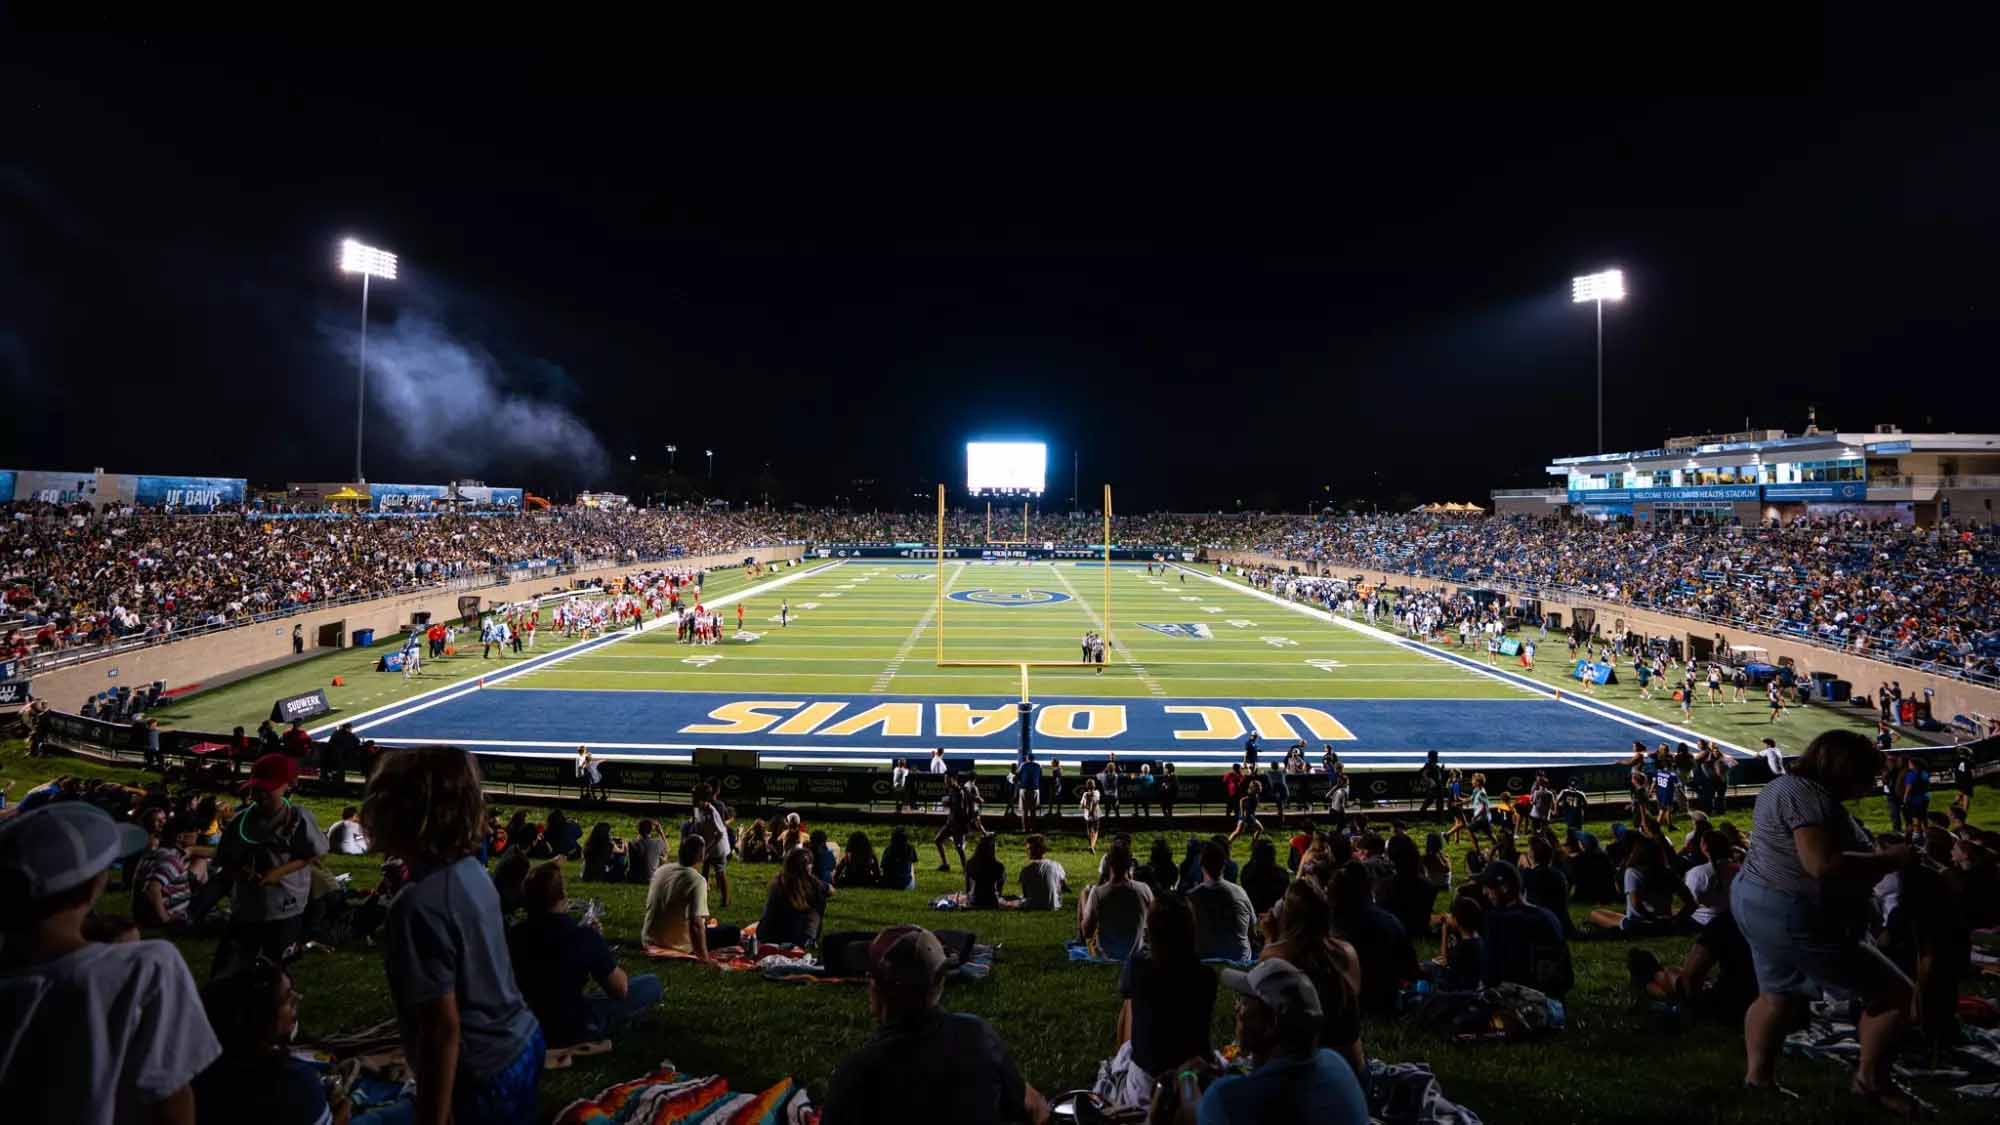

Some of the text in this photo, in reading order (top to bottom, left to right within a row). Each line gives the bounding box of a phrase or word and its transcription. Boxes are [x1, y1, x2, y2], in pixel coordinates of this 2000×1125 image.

[185, 490, 221, 506] DAVIS
[380, 494, 406, 507] AGGIE
[1701, 489, 1724, 498] HEALTH
[1726, 489, 1757, 497] STADIUM
[676, 700, 1359, 742] UC DAVIS
